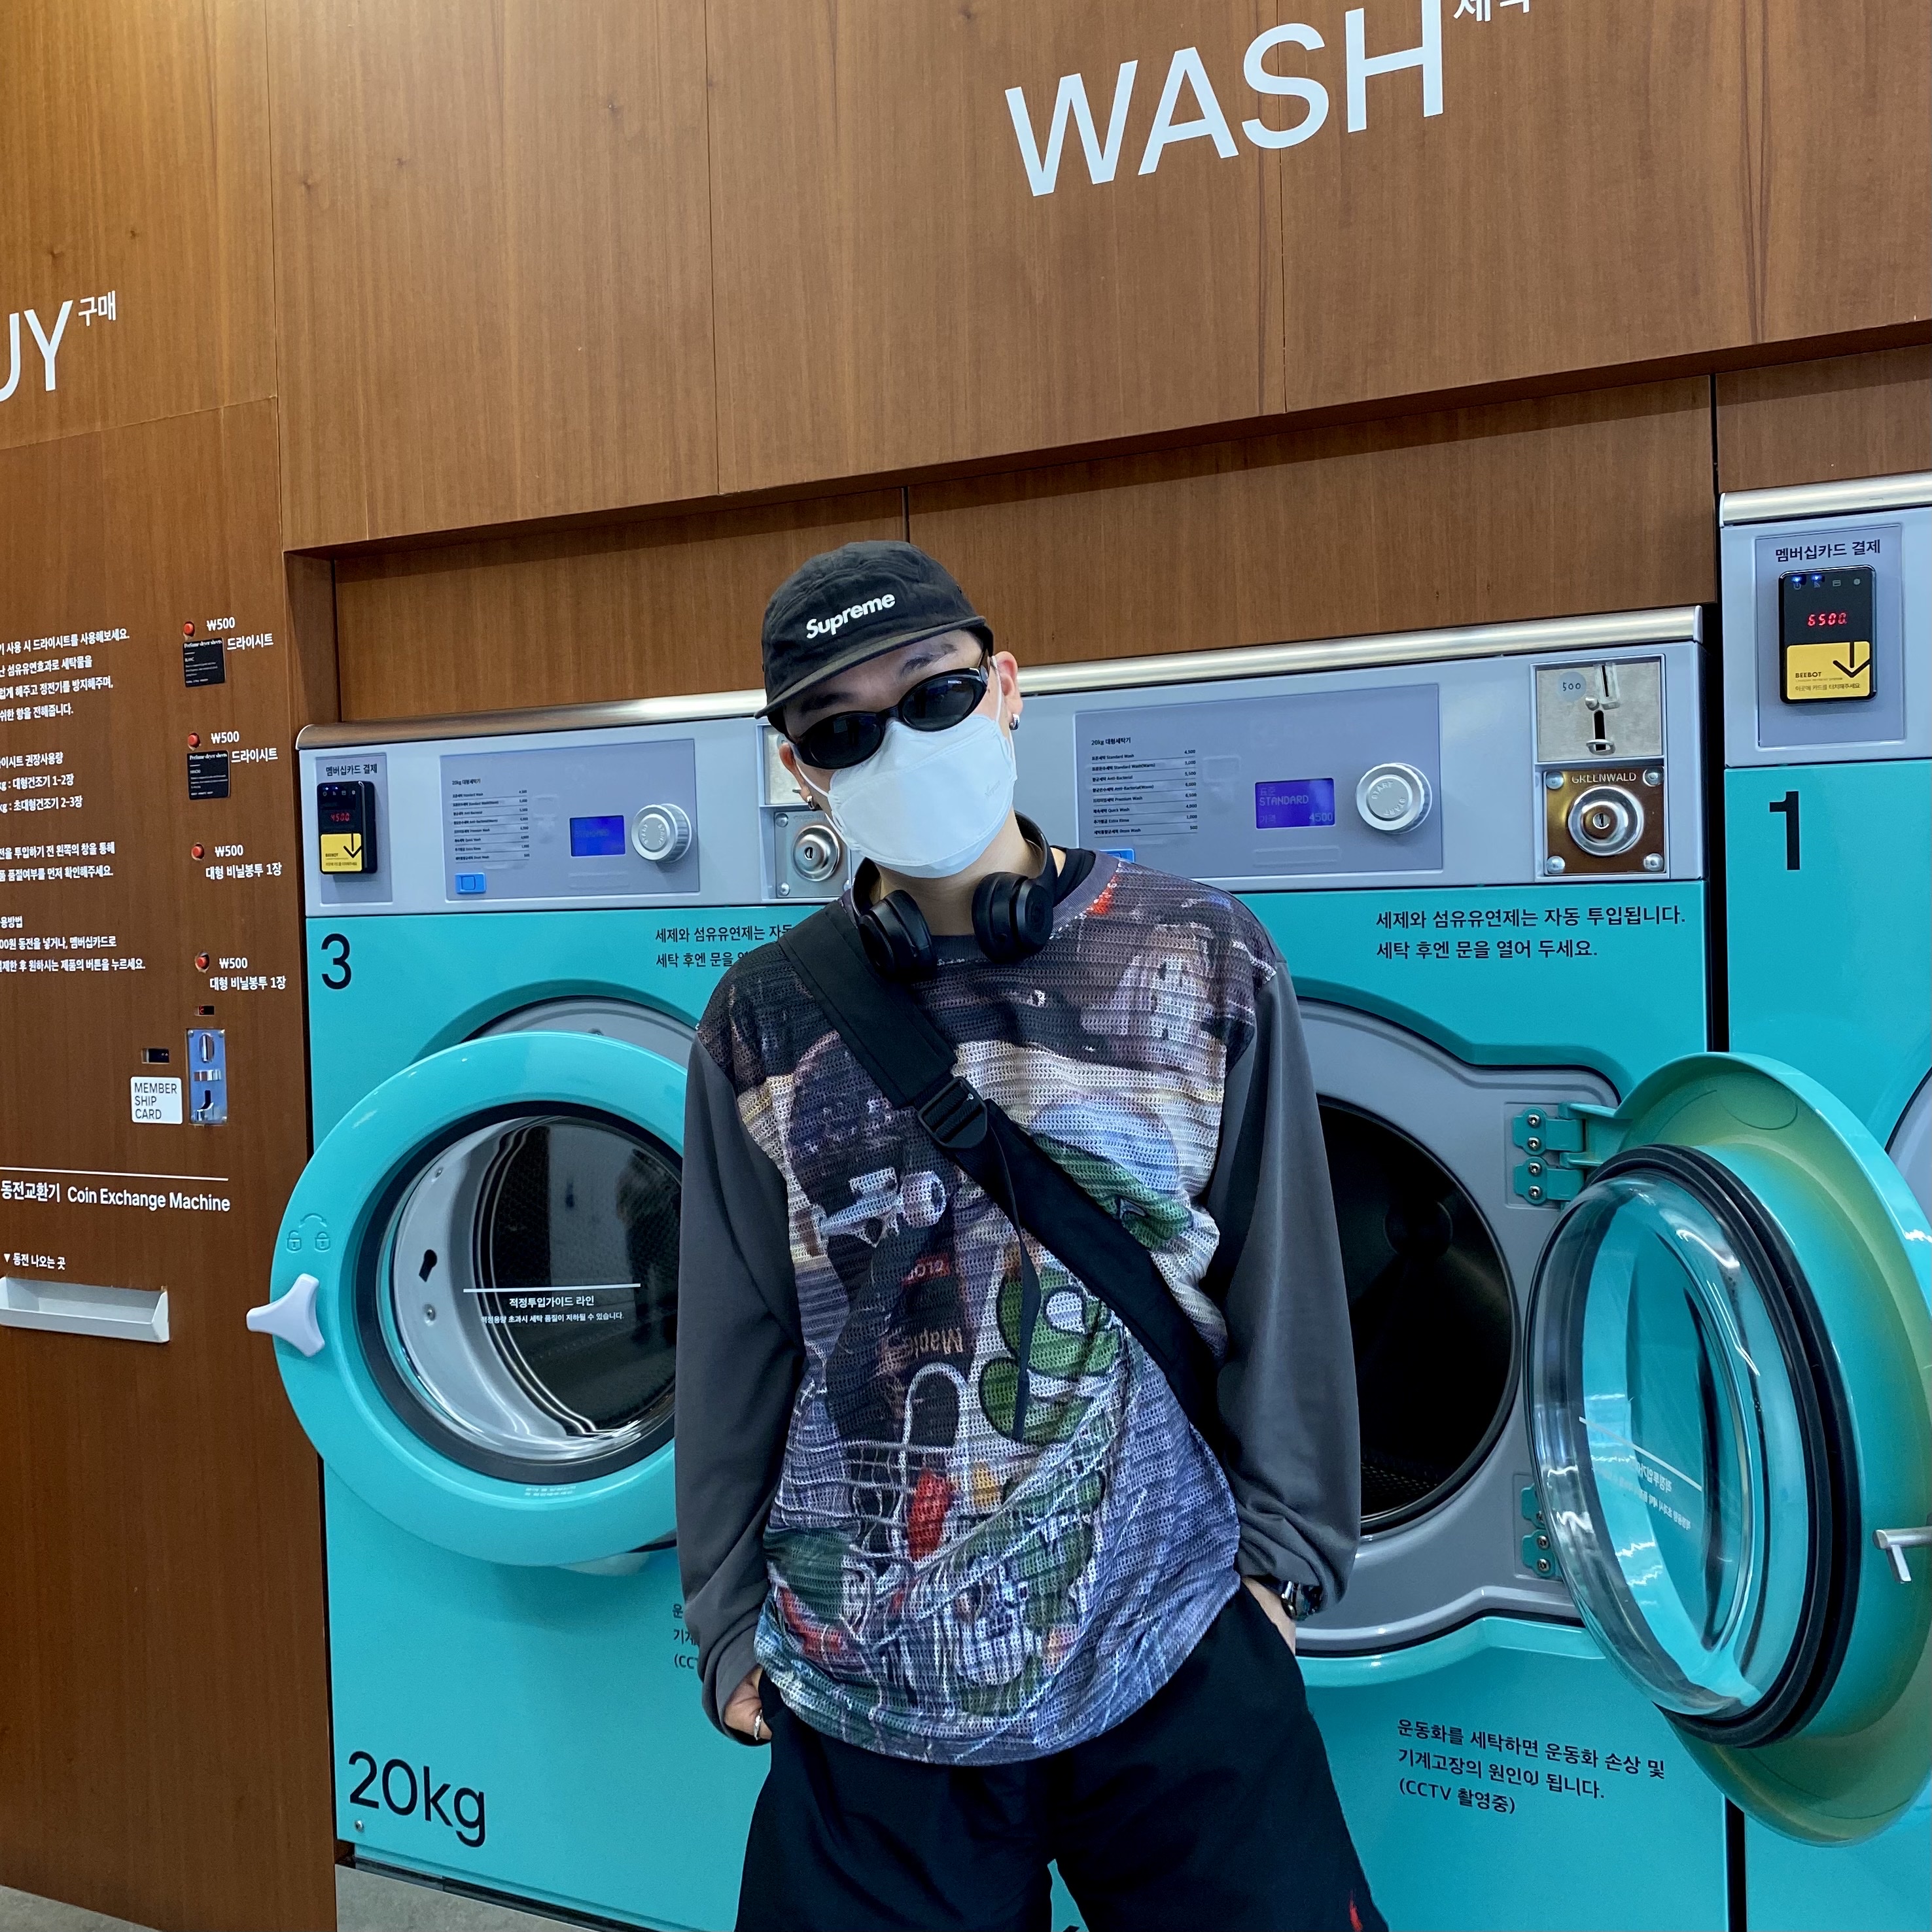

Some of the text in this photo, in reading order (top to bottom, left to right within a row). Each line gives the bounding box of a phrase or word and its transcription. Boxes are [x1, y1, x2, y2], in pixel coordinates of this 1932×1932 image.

[1005, 0, 1443, 196] WASH
[78, 290, 116, 327] 구매
[1776, 539, 1880, 562] 멤버십카드 결제
[206, 616, 236, 631] ₩500
[807, 594, 896, 639] Supreme
[1807, 612, 1848, 626] 6500
[7, 628, 130, 654] 사용 시 드라이시트를 사용해보세요.
[226, 633, 274, 650] 드라이시트
[7, 655, 92, 677] 섬유유연효과로 세탁물을
[15, 684, 38, 698] 해주고
[40, 680, 70, 695] 정전기를
[72, 675, 113, 692] 방지해주며,
[1562, 682, 1581, 692] 500
[16, 707, 31, 720] 항을
[33, 703, 74, 719] 전해줍니다.
[211, 731, 239, 744] ₩500
[0, 752, 63, 769] 이시트 권장사용량
[231, 747, 278, 763] 드라이시트
[326, 764, 378, 777] 멤버십카드 결제
[12, 775, 50, 790] 대형건조기
[52, 773, 75, 786] 1-2장
[13, 797, 59, 811] 초대형건조기
[60, 795, 83, 808] 2-3장
[1259, 795, 1309, 806] STANDARD
[330, 813, 351, 822] 4500
[1309, 812, 1333, 822] 4500
[1769, 791, 1800, 870] 1
[14, 845, 44, 859] 투입하기
[46, 845, 54, 858] 전
[56, 843, 80, 857] 왼쪽의
[81, 842, 97, 856] 창을
[99, 841, 115, 854] 통해
[215, 845, 243, 857] ₩500
[8, 865, 114, 882] 품절여부를 먼저 확인해주세요.
[205, 862, 282, 880] 대형 비닐봉투 1장
[0, 915, 23, 929] 용방법
[1376, 905, 1685, 929] 세제와 섬유유연제는 자동 투입됩니다.
[18, 937, 41, 950] 동전을
[43, 936, 68, 950] 넣거나,
[70, 936, 116, 949] 멤버십카드로
[656, 927, 690, 943] 세제와
[694, 926, 765, 942] 섬유유연제는
[1376, 939, 1598, 960] 세탁 후엔 문을 열어 두세요.
[19, 960, 27, 972] 후
[29, 959, 59, 972] 원하시는
[61, 958, 84, 972] 제품의
[85, 958, 110, 972] 버튼을
[111, 958, 146, 971] 누르세요.
[219, 957, 248, 969] ₩500
[321, 933, 352, 990] 3
[656, 952, 679, 968] 세탁
[682, 952, 706, 968] 후엔
[710, 951, 734, 967] 문을
[209, 975, 286, 991] 대형 비닐봉투 1장
[135, 1083, 177, 1095] MEMBER
[135, 1096, 157, 1106] SHIP
[135, 1108, 162, 1120] CARD
[1, 1180, 230, 1212] 동전교환기 Coin Exchange Machine
[13, 1252, 66, 1271] 동전 나오는 곳
[509, 1295, 595, 1308] 적정투입가이드 라인
[508, 1314, 528, 1324] 초과시
[529, 1314, 543, 1323] 세탁
[588, 1312, 595, 1322] 수
[596, 1312, 625, 1321] 있습니다.
[1397, 1718, 1665, 1780] 운동화를 세탁하면 운동화 손상 및
[1398, 1748, 1605, 1799] 기계고장의 원인이 됩니다.
[349, 1751, 485, 1848] 20kg
[1399, 1777, 1516, 1814] (CCTV 촬영중)
